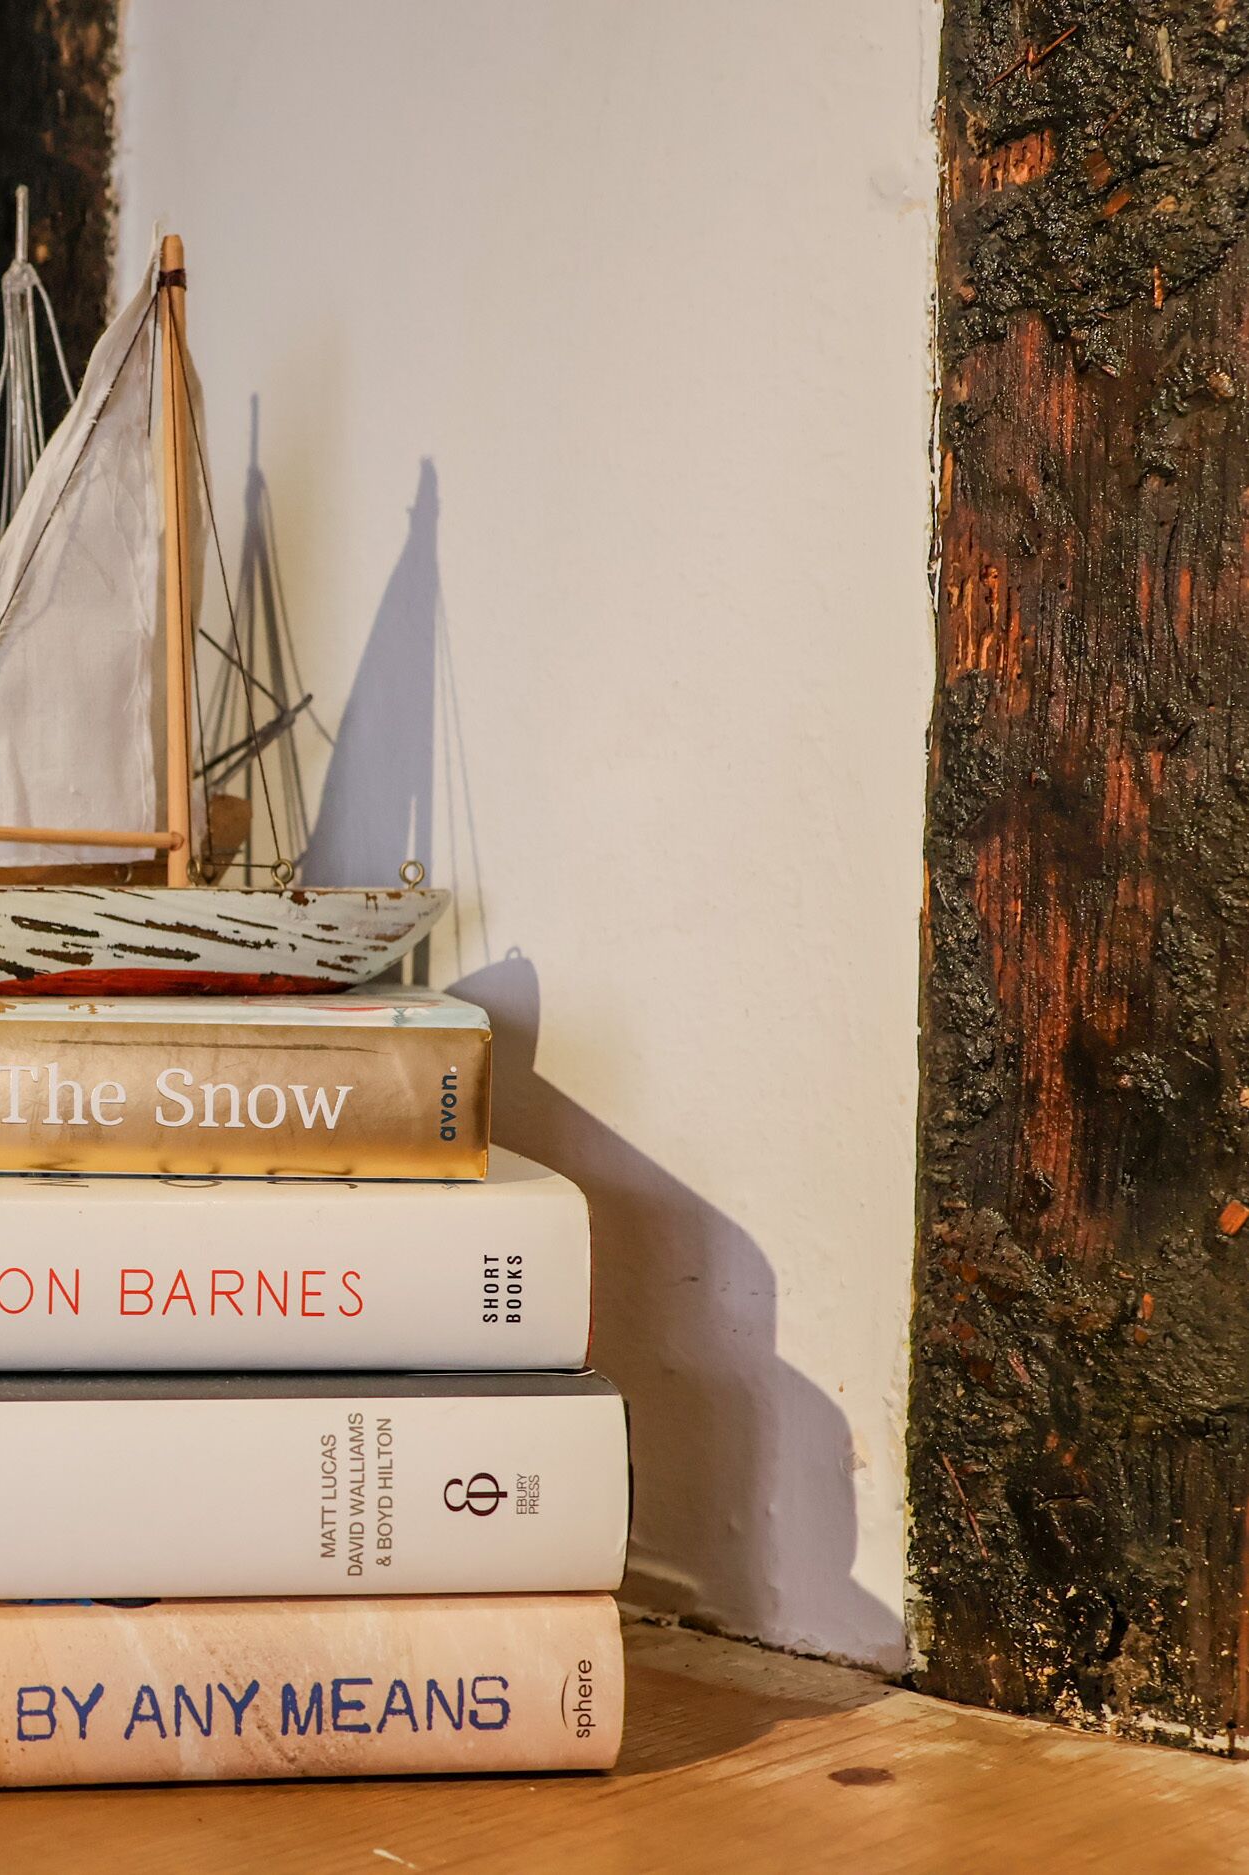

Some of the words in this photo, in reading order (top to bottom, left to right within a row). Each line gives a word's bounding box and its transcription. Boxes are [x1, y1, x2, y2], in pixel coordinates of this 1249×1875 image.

[153, 1066, 353, 1131] Snow
[119, 1268, 365, 1317] BARNES
[482, 1253, 500, 1324] SHORT
[505, 1254, 523, 1324] BOOKS
[320, 1433, 338, 1501] LUCAS
[347, 1411, 365, 1518] WALLIAMS
[375, 1417, 394, 1490] HILTON
[375, 1493, 394, 1550] BOYD
[516, 1473, 528, 1515] EBURY
[529, 1474, 540, 1515] PRESS
[320, 1504, 338, 1559] MATT
[347, 1519, 365, 1577] DAVID
[375, 1555, 392, 1567] &
[16, 1682, 105, 1742] BY
[124, 1680, 260, 1740] ANY
[280, 1675, 511, 1736] MEANS
[572, 1659, 594, 1739] sphere
